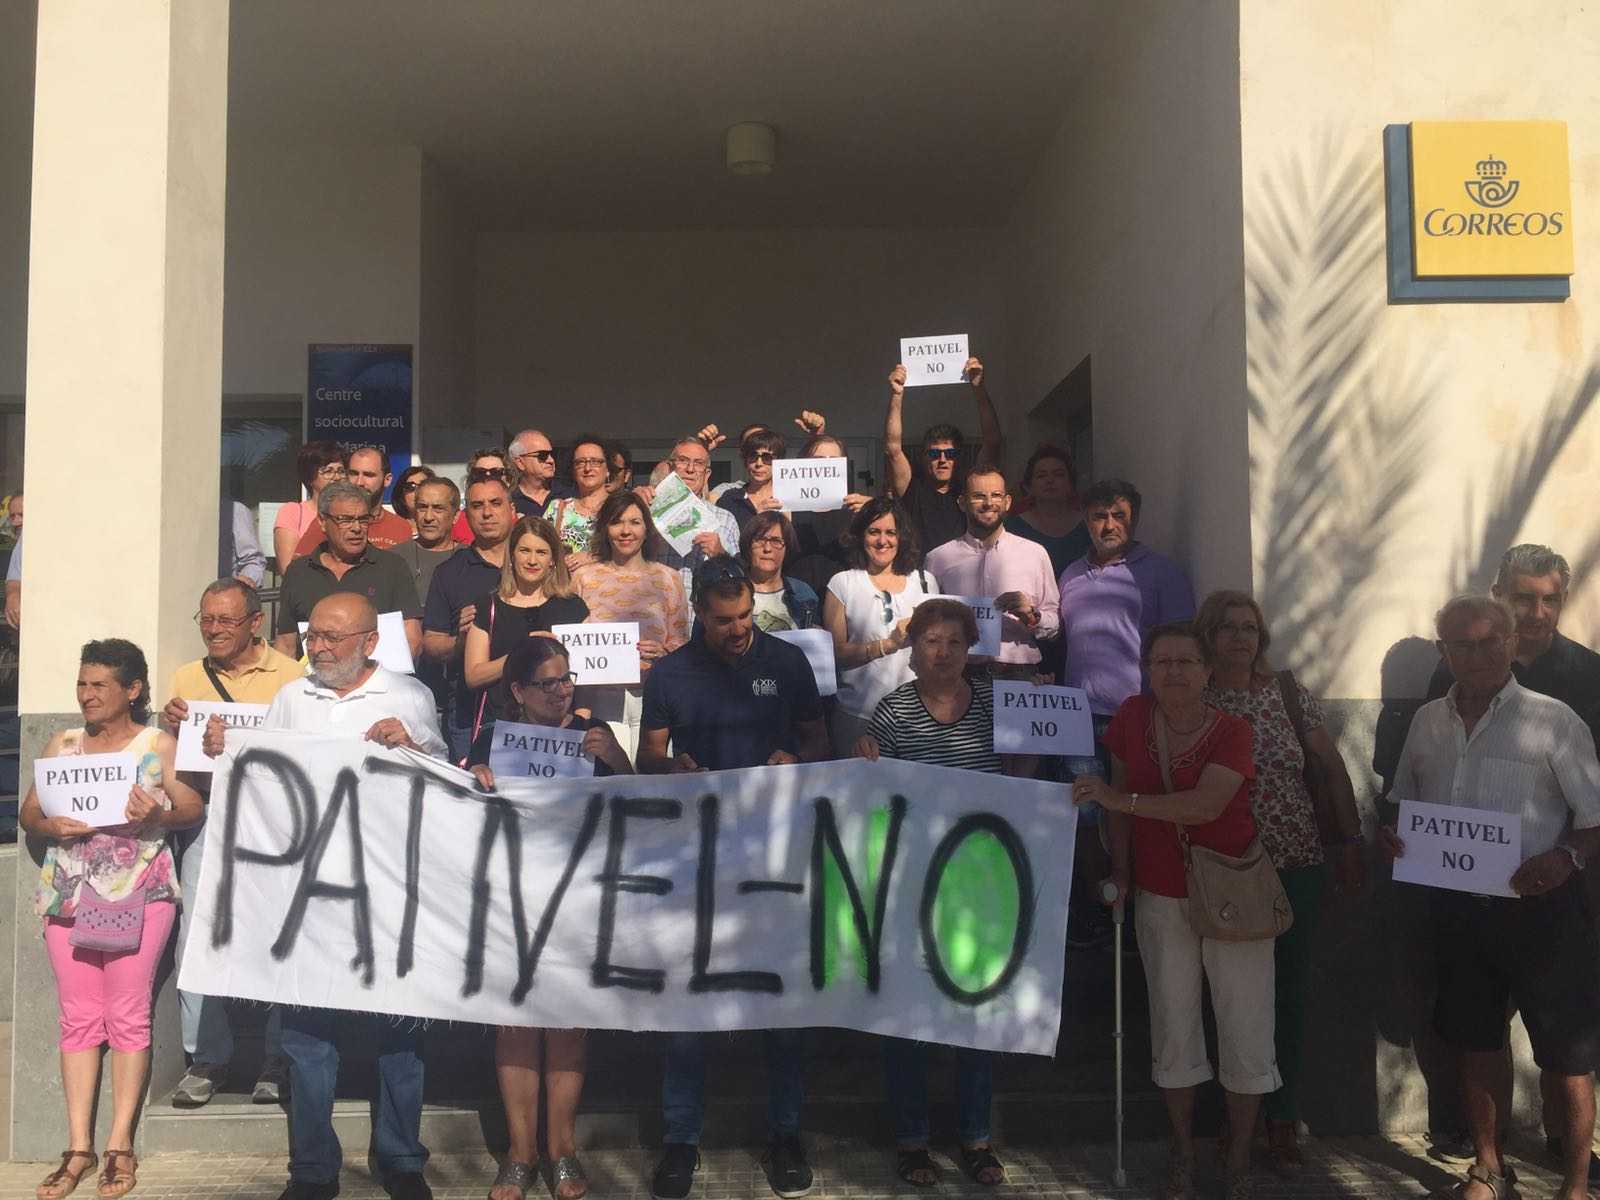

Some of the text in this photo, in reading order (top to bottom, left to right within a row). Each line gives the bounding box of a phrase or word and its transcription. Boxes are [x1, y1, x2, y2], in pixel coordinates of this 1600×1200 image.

[1424, 208, 1564, 237] CORREOS
[908, 343, 962, 356] PATIVEL
[927, 362, 945, 373] NO
[315, 387, 362, 401] Centre
[314, 415, 405, 429] sociocultural
[780, 466, 840, 479] PATIVEL
[800, 487, 820, 498] NO
[561, 633, 631, 646] PATIVEL
[585, 657, 608, 669] NO
[1003, 692, 1082, 711] PATIVEL
[1031, 721, 1058, 737] NO
[46, 766, 127, 785] PATIVEL
[527, 762, 556, 778] NO
[72, 796, 99, 812] NO
[1410, 815, 1511, 844] PATIVEL
[1442, 851, 1475, 871] NO
